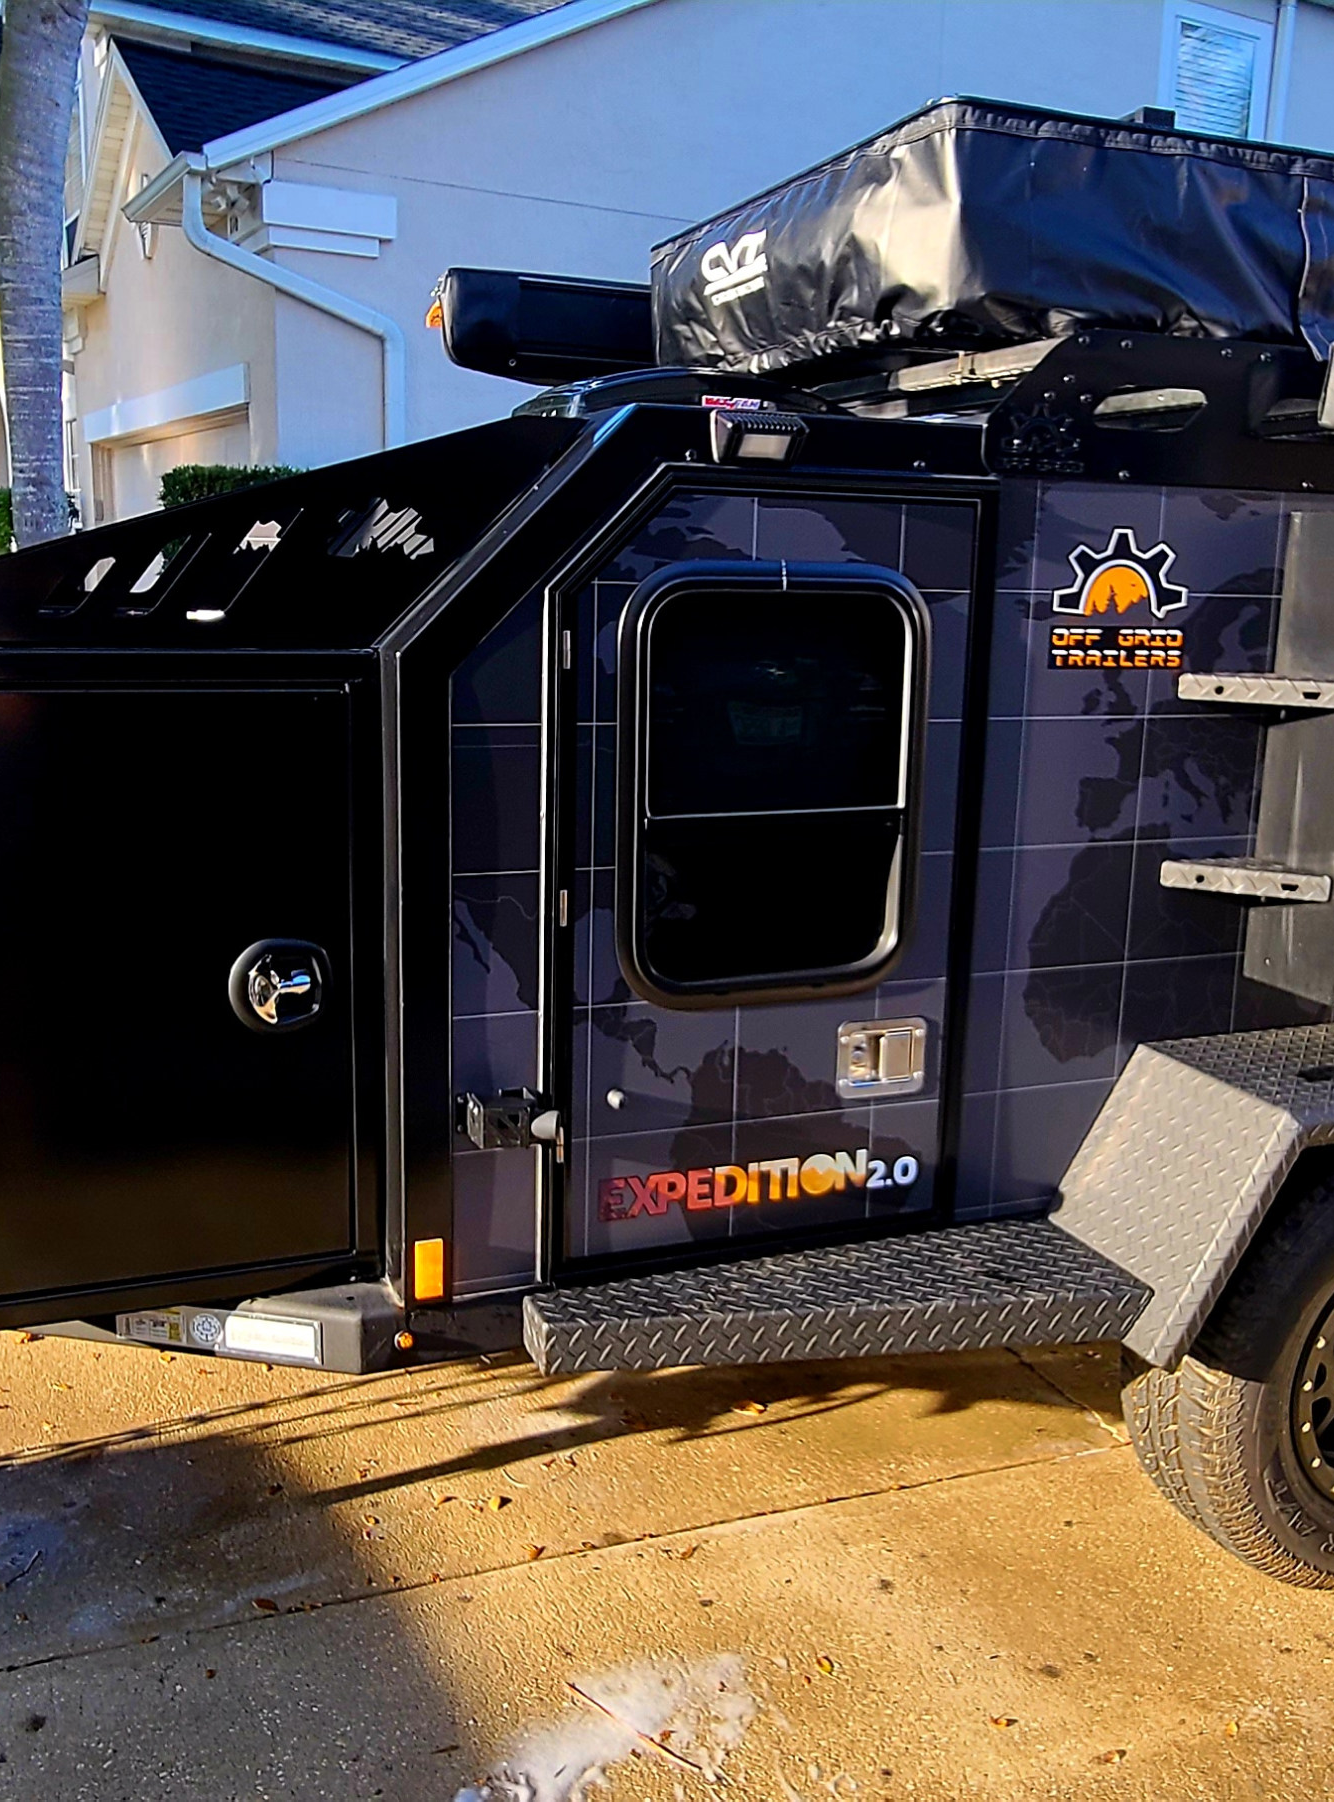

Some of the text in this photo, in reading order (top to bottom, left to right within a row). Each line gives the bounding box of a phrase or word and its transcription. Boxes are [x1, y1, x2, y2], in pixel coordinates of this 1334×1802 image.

[1052, 628, 1183, 647] OFF GRID
[1051, 649, 1182, 667] TRAILERS
